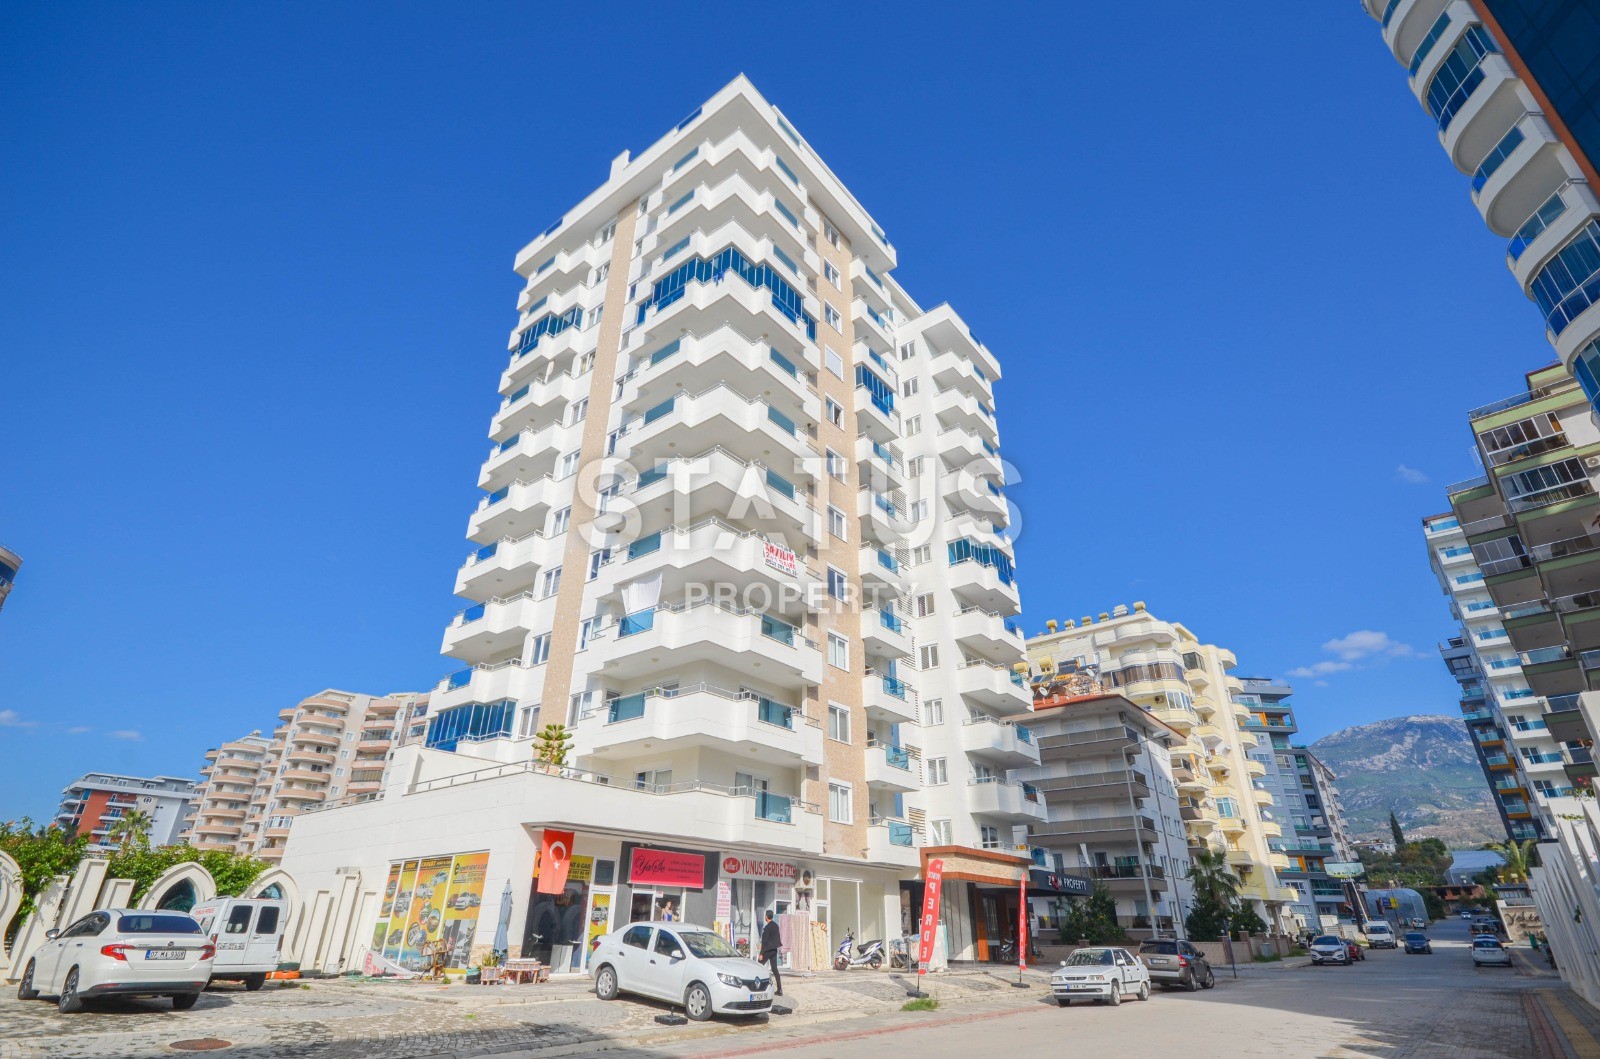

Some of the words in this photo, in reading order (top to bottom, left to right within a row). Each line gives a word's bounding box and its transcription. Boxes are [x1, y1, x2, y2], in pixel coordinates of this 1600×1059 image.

[741, 859, 763, 876] YUNUS
[764, 861, 784, 878] PERDE
[1063, 877, 1087, 891] PROPERTY
